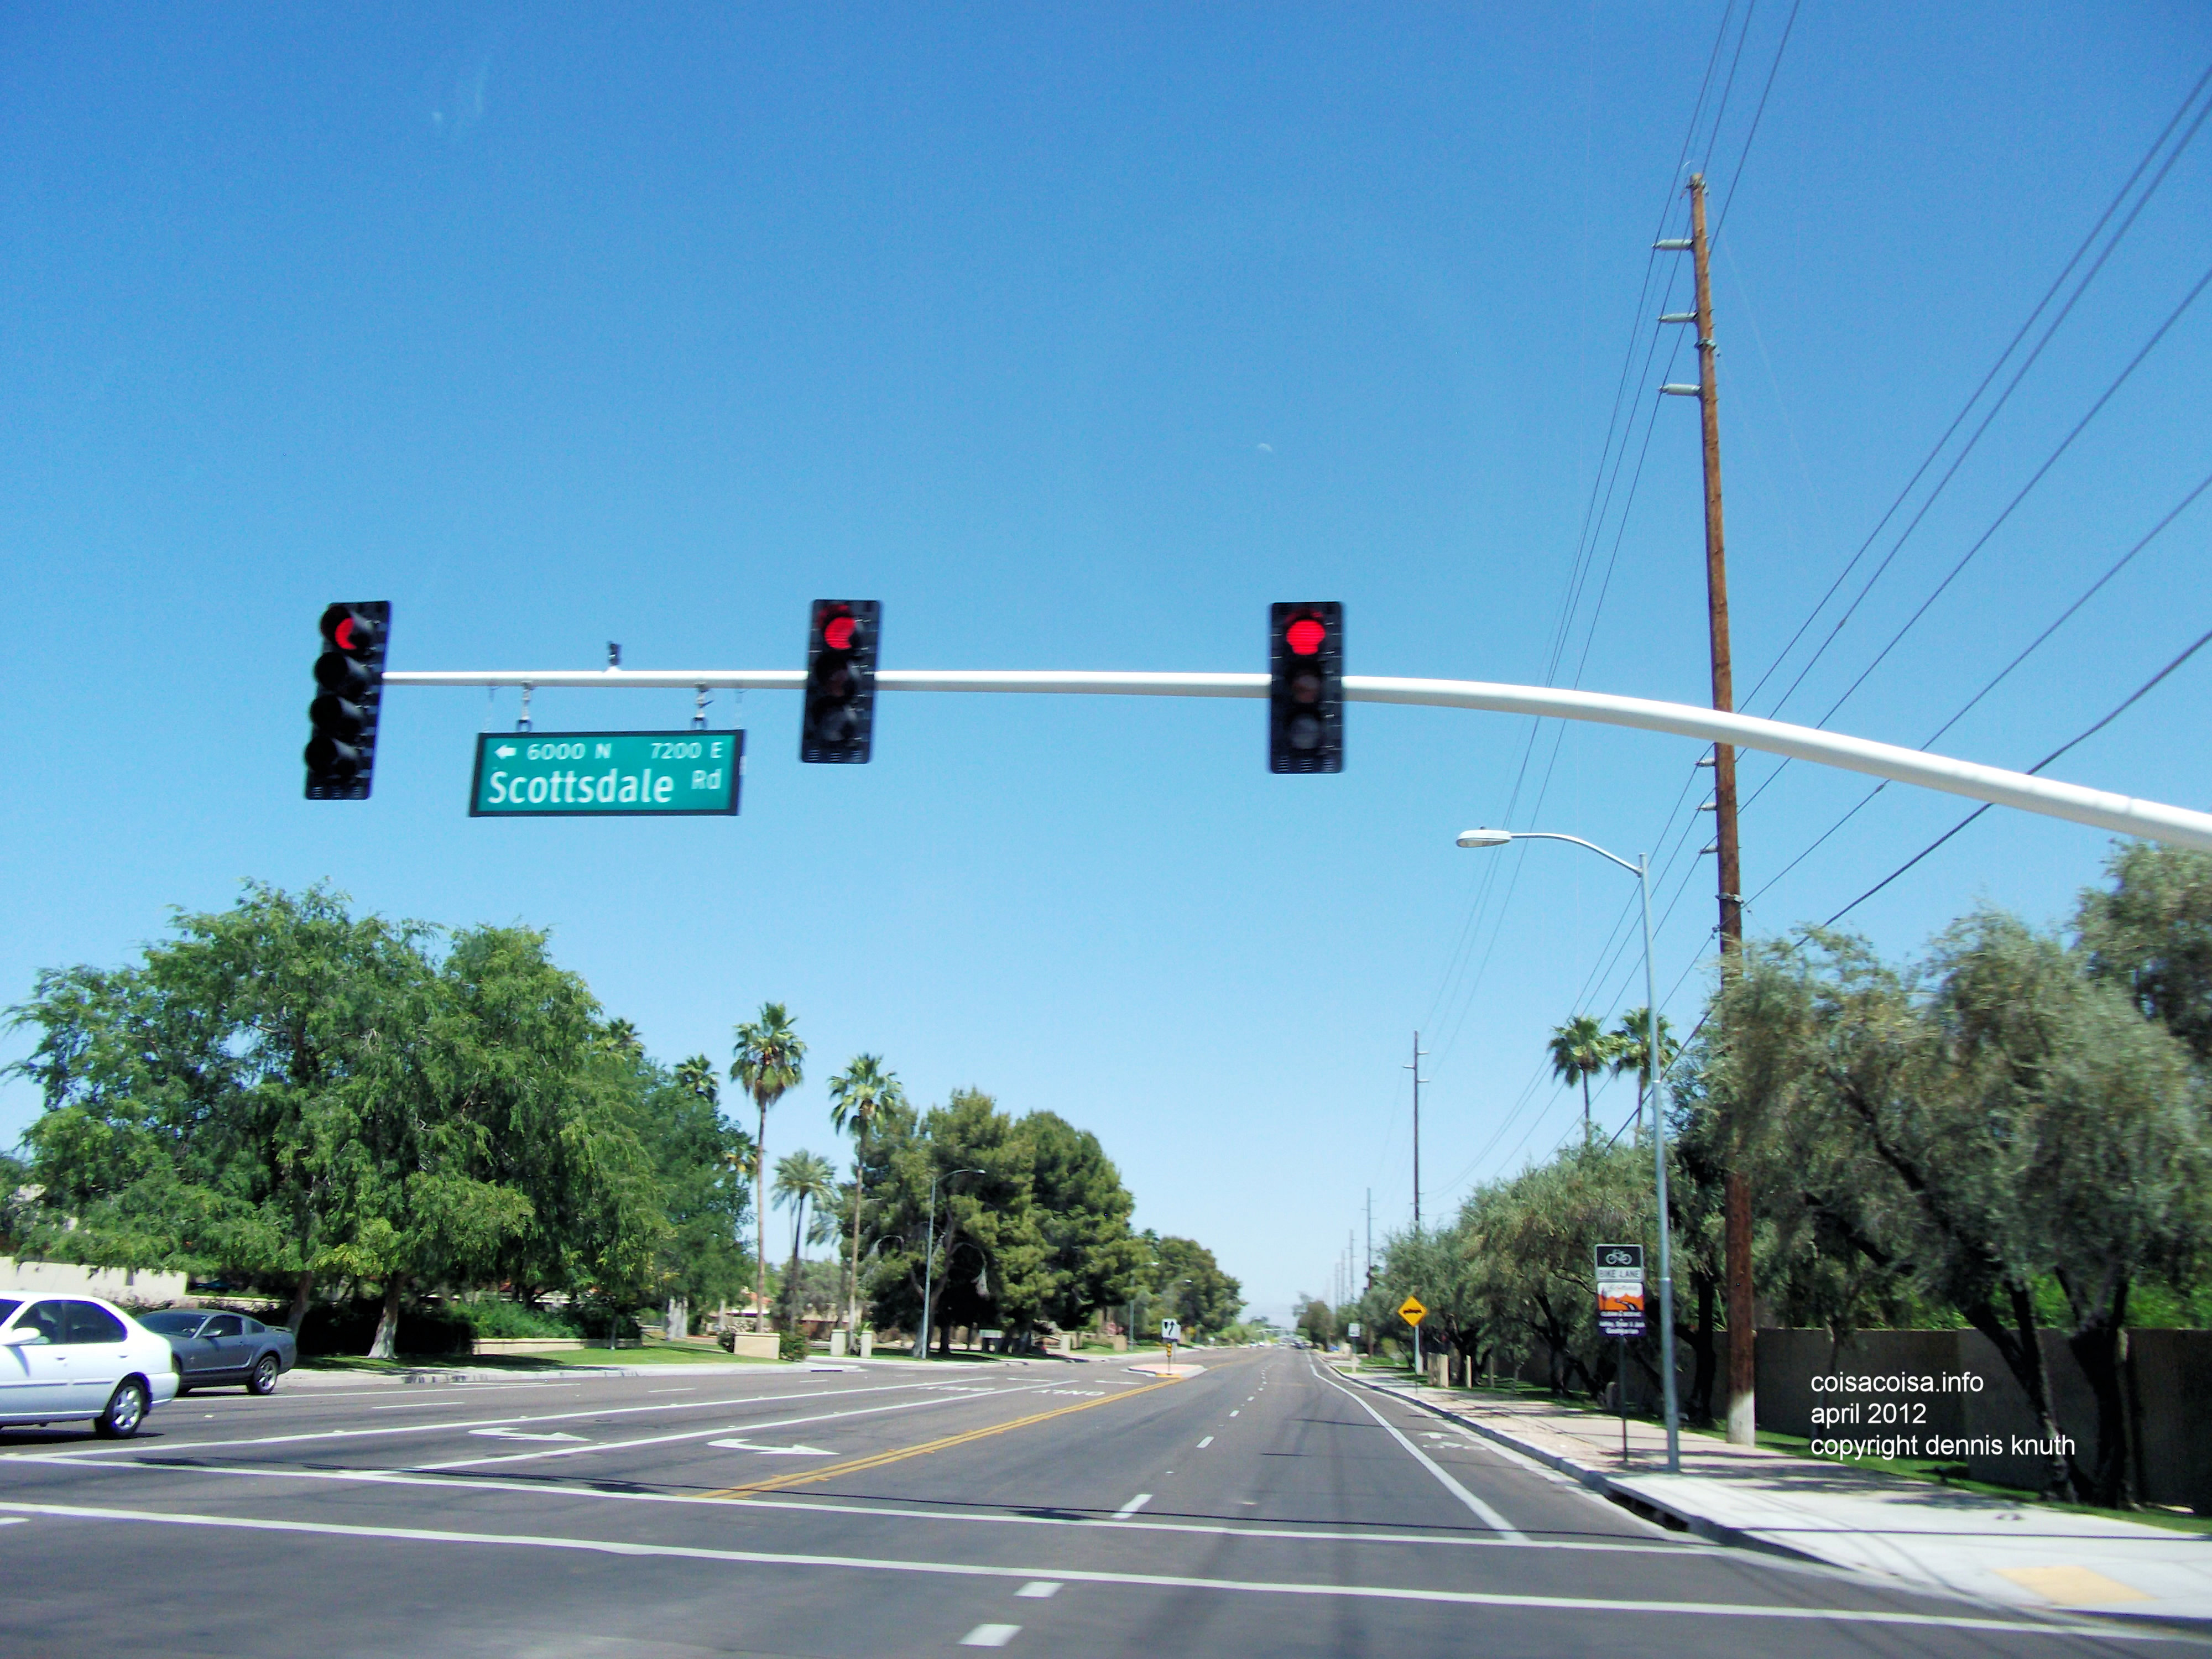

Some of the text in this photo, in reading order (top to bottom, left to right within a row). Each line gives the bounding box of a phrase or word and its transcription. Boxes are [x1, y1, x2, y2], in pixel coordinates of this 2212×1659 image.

[526, 743, 611, 760] 6000 N
[650, 742, 723, 759] 7200 E
[487, 768, 722, 804] Scottsdale Rd
